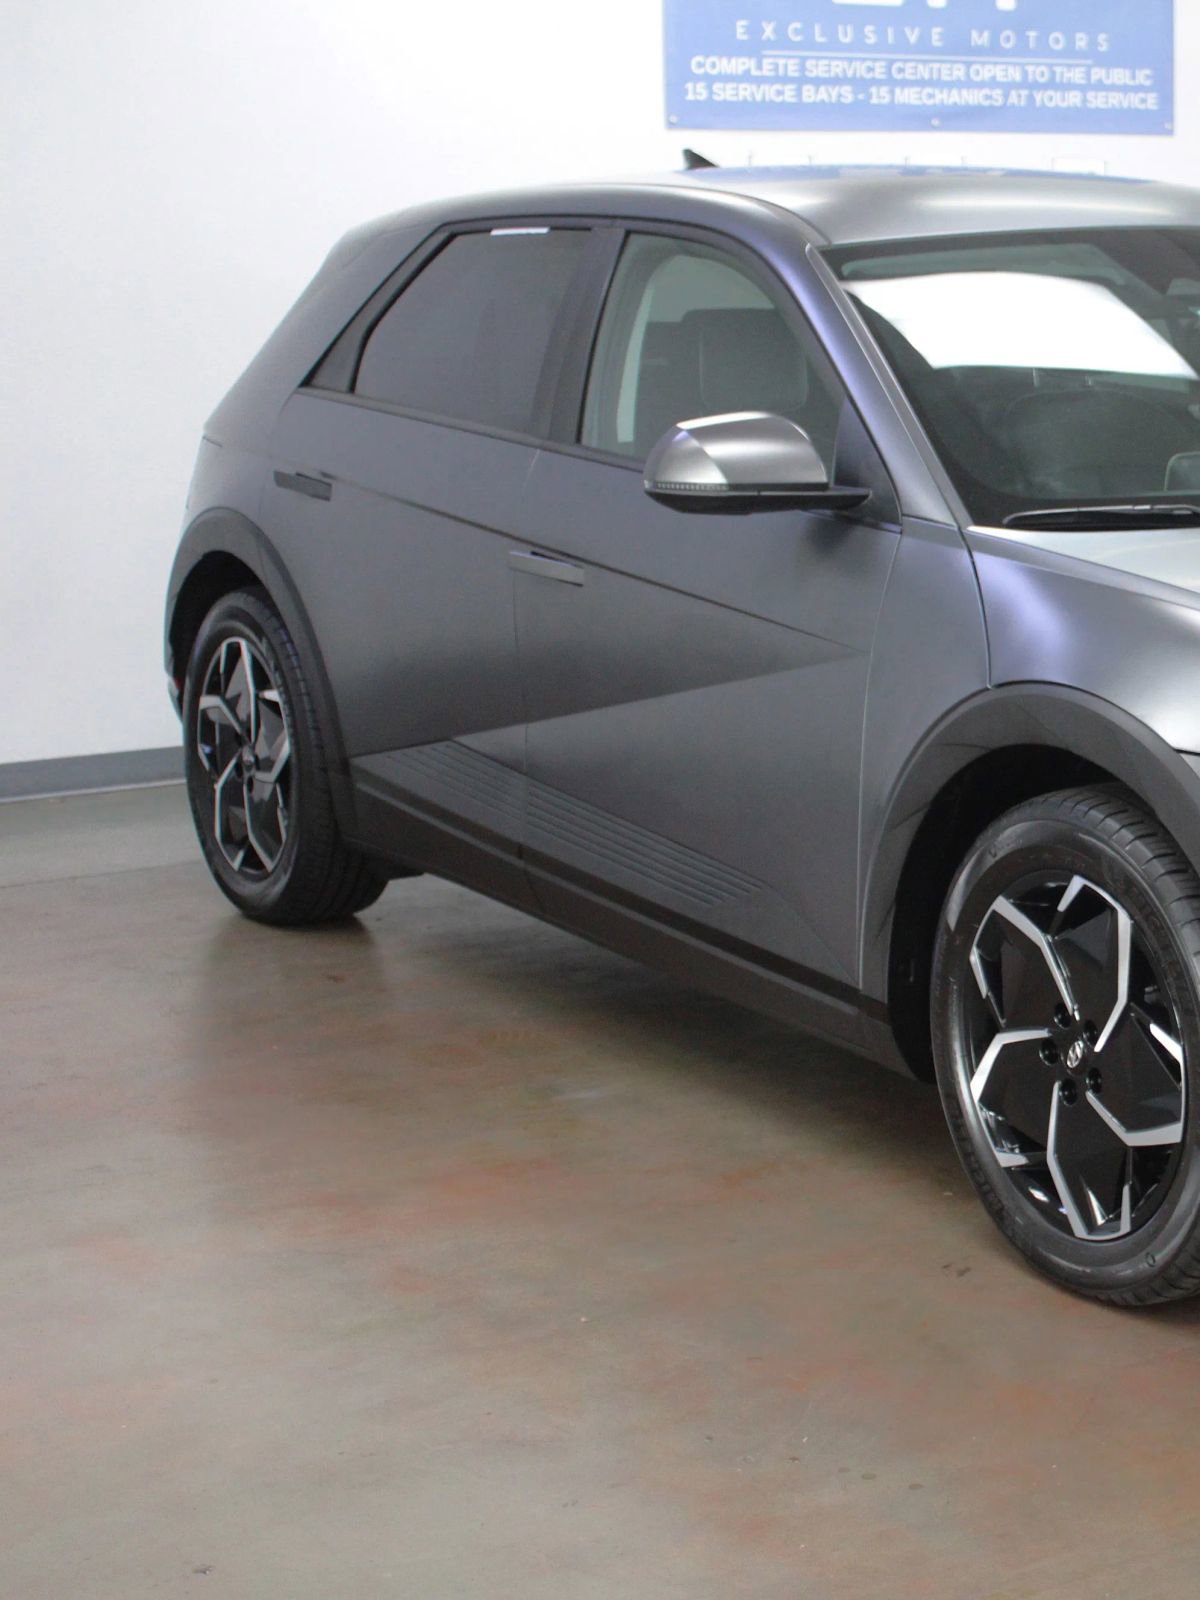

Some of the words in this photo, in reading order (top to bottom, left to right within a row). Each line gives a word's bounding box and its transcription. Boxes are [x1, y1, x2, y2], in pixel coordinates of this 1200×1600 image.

[736, 20, 944, 47] EXCLUSIVE
[971, 29, 1111, 51] MOTORS
[690, 55, 800, 77] COMPLETE
[805, 59, 887, 79] SERVICE
[891, 61, 965, 81] CENTER
[969, 63, 1022, 82] OPEN
[1024, 65, 1049, 83] TO
[1053, 66, 1088, 84] THE
[1091, 67, 1152, 86] PUBLIC
[685, 82, 707, 101] 15
[712, 82, 799, 102] SERVICE
[802, 84, 854, 103] BAYS
[870, 86, 891, 104] 15
[895, 86, 1004, 107] MECHANICS
[1007, 89, 1028, 107] AT
[1031, 90, 1084, 108] YOUR
[1087, 91, 1159, 110] SERVICE
